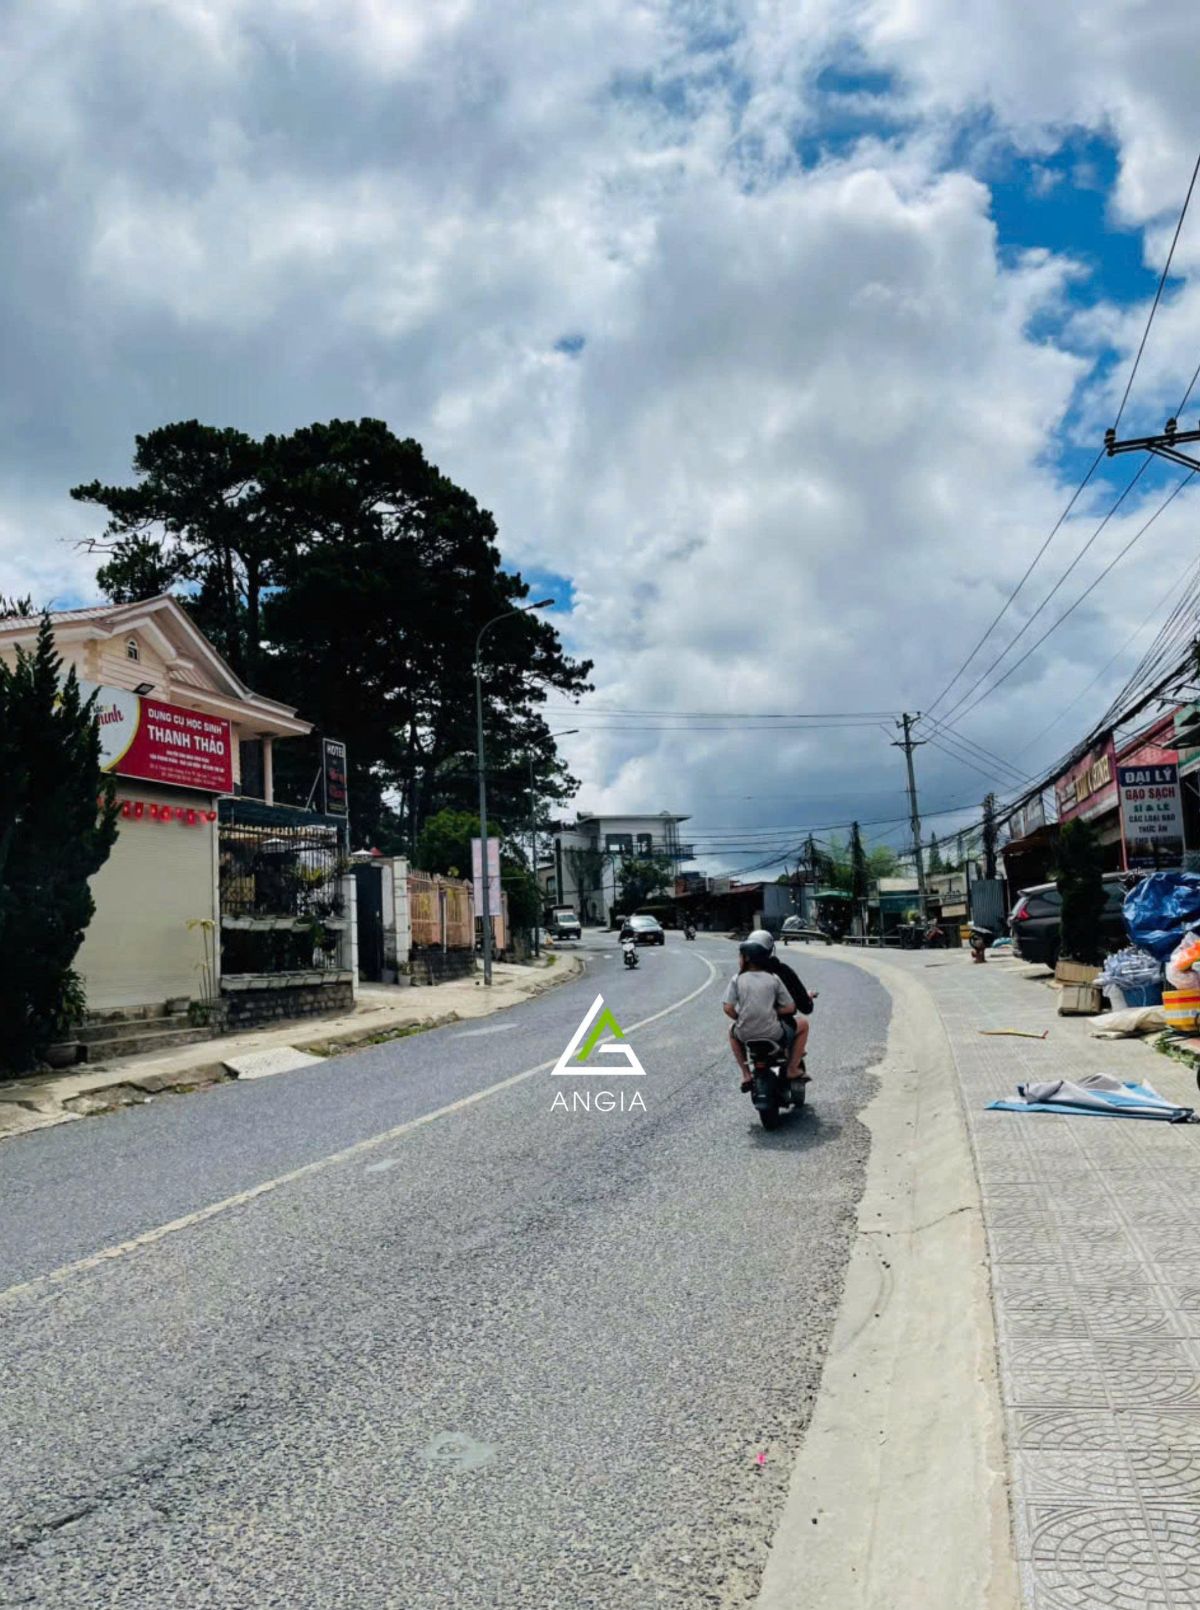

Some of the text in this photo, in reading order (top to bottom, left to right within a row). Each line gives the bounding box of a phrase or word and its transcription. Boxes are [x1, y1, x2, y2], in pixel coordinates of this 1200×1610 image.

[203, 722, 222, 735] SINH
[147, 724, 191, 749] THANH
[193, 734, 225, 756] THẢO
[1125, 786, 1176, 802] GẠO SẠCH
